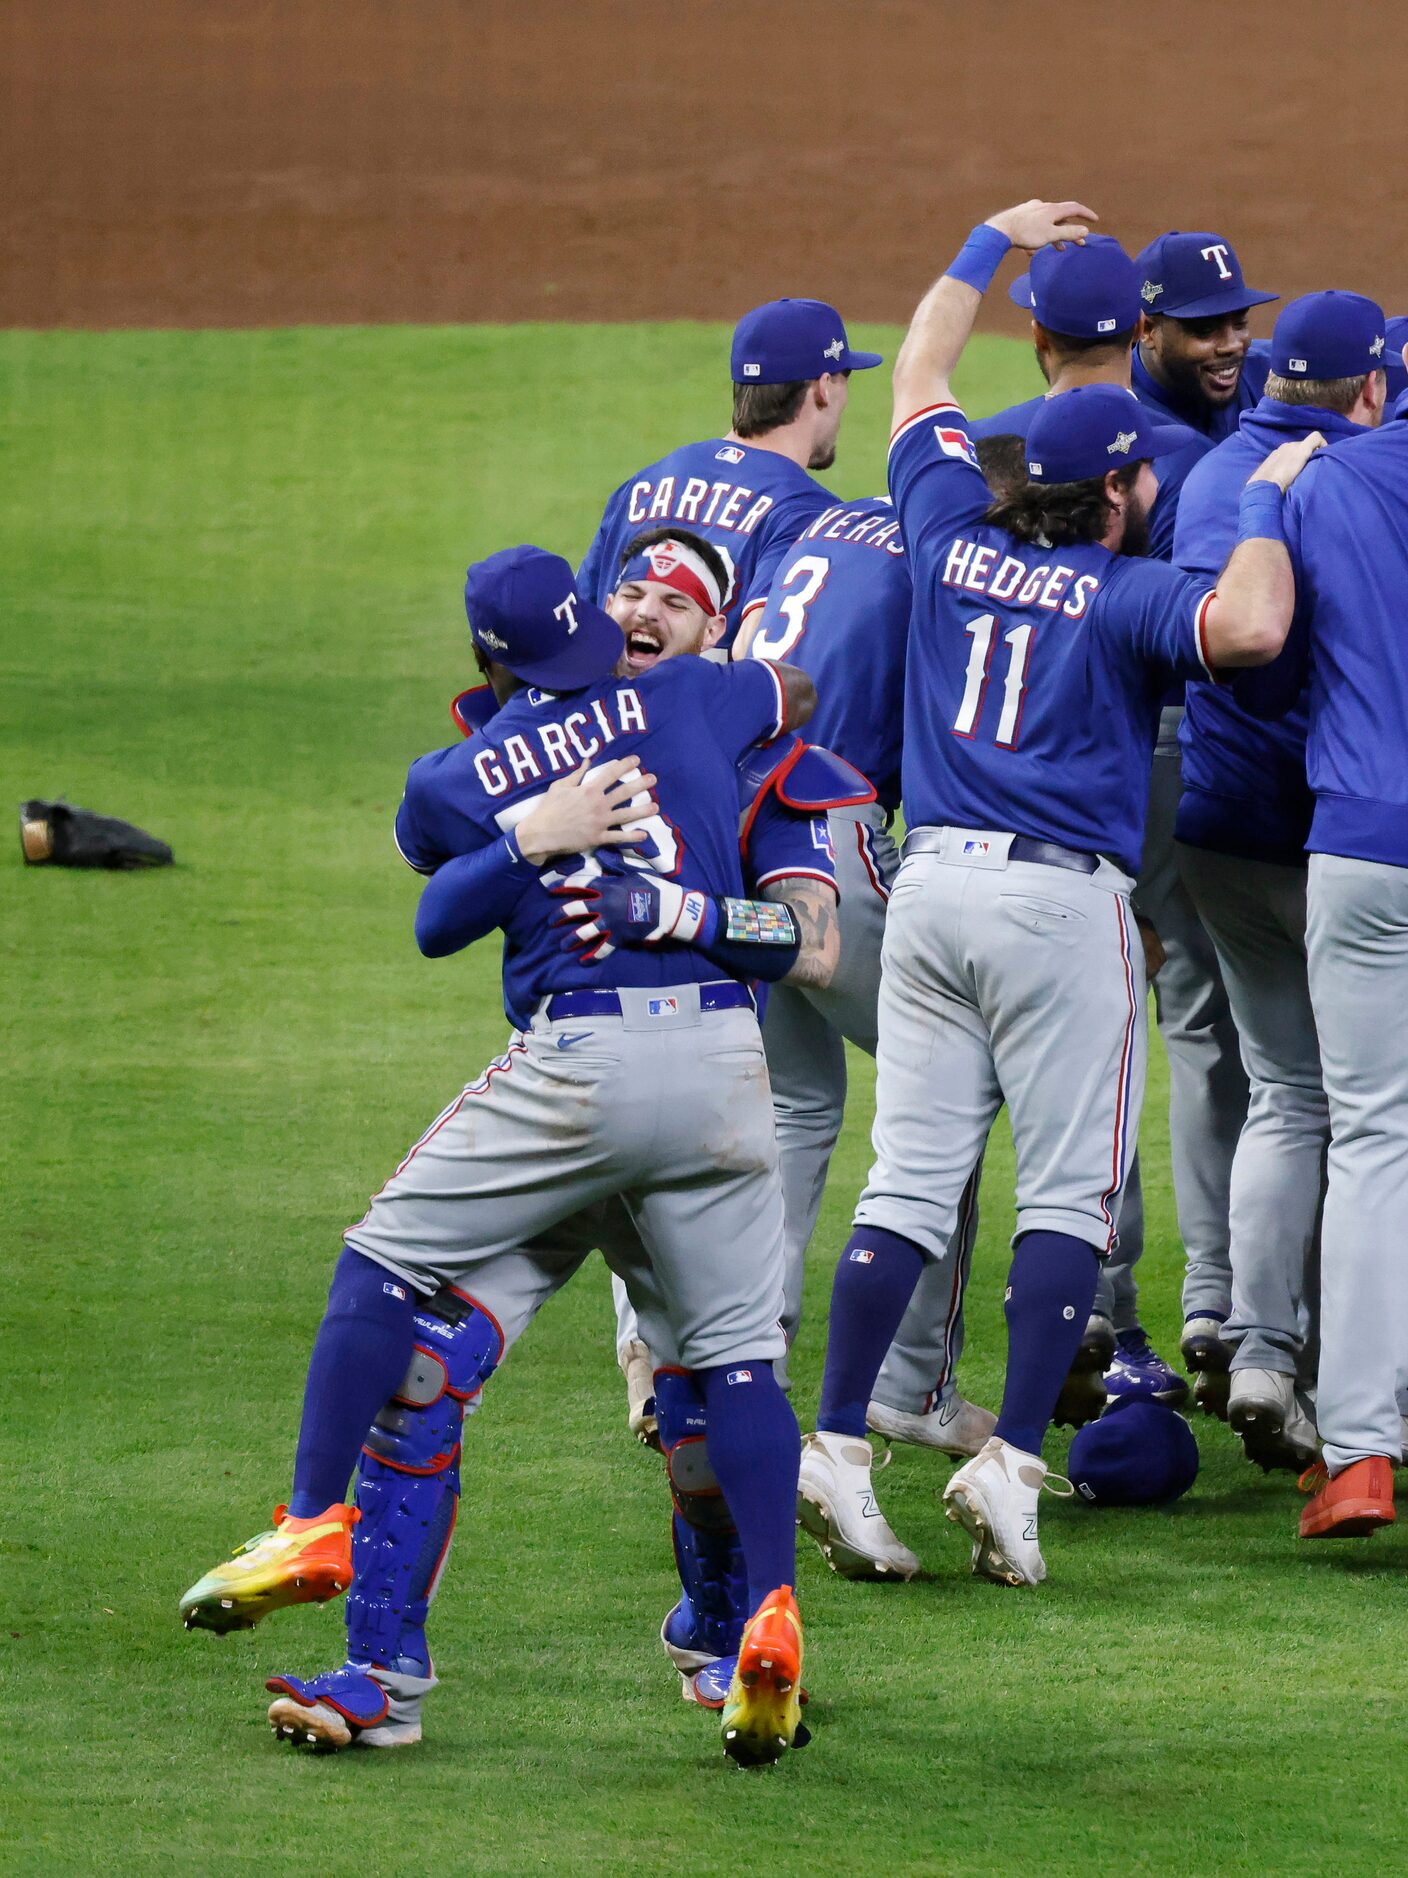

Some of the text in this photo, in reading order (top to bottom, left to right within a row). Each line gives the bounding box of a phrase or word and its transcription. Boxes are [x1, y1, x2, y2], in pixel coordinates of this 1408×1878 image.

[1200, 244, 1233, 281] T
[627, 476, 774, 535] CARTER
[798, 508, 907, 555] VERA
[942, 538, 1100, 619] HEDGES
[552, 591, 579, 635] T
[752, 555, 831, 661] 3
[951, 613, 1036, 751] 11
[473, 688, 649, 797] GARCIA
[685, 897, 702, 922] JH
[412, 1315, 455, 1339] AWLINGS
